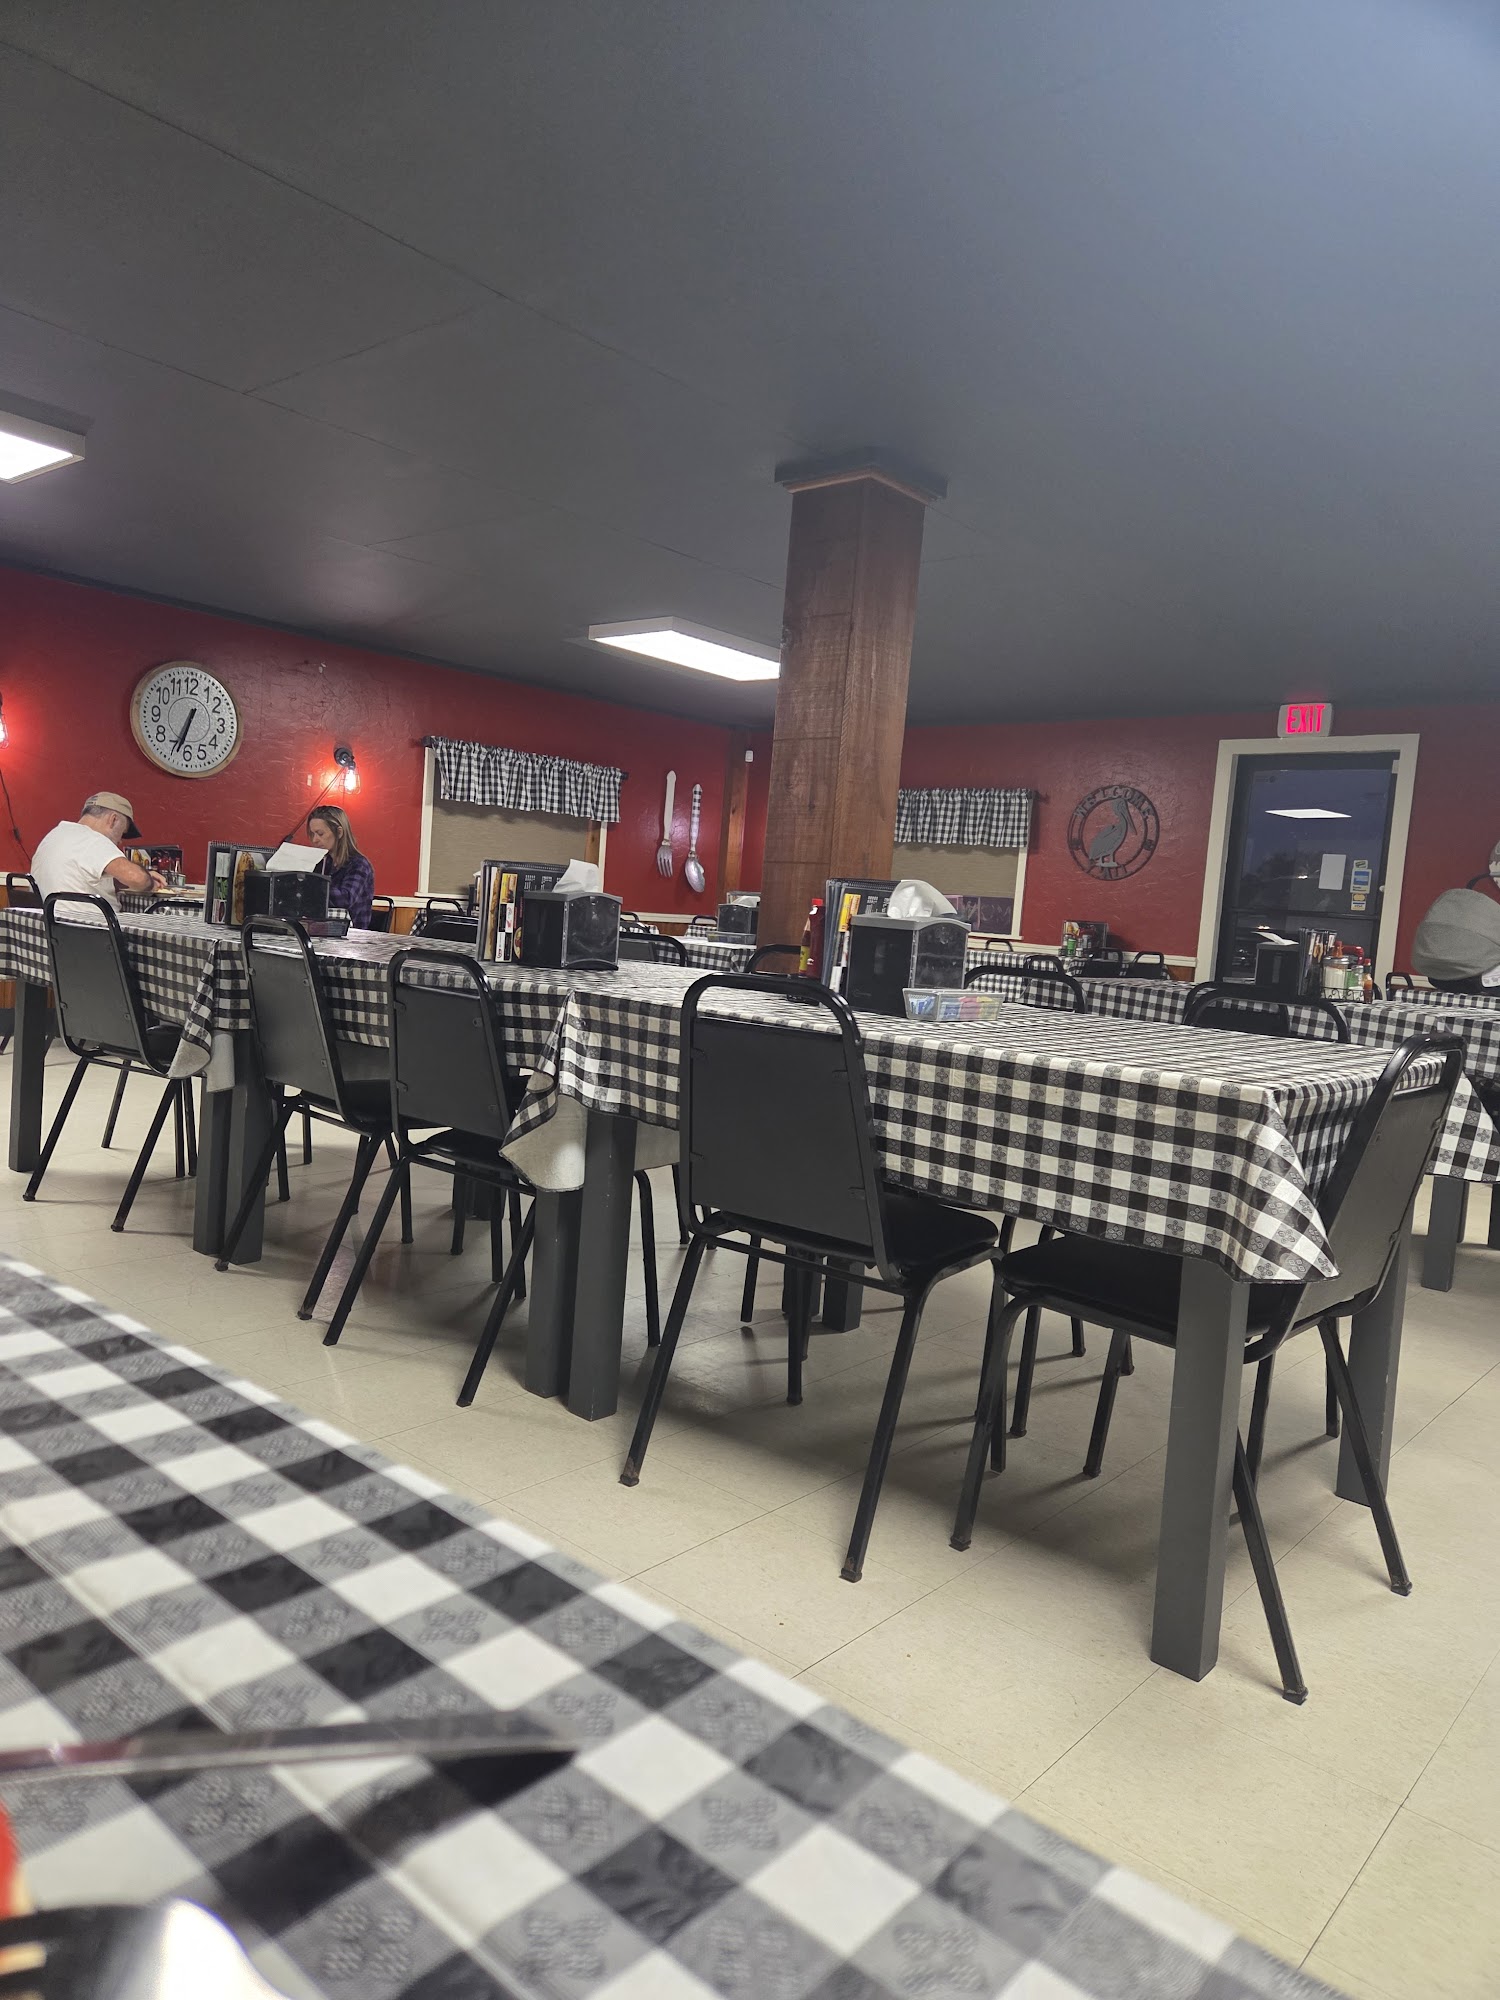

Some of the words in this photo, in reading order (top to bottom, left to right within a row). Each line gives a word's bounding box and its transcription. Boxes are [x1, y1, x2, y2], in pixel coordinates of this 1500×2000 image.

[170, 677, 182, 696] 11
[184, 676, 199, 696] 12
[203, 685, 210, 704] 1
[155, 686, 171, 705] 10
[151, 705, 161, 723] 9
[211, 696, 222, 714] 2
[216, 717, 226, 734] 3
[1286, 704, 1326, 734] EXIT
[155, 725, 166, 743] 8
[208, 734, 219, 750] 4
[168, 739, 179, 756] 7
[182, 744, 193, 762] 6
[196, 743, 207, 760] 5
[1073, 785, 1156, 820] WELCOME
